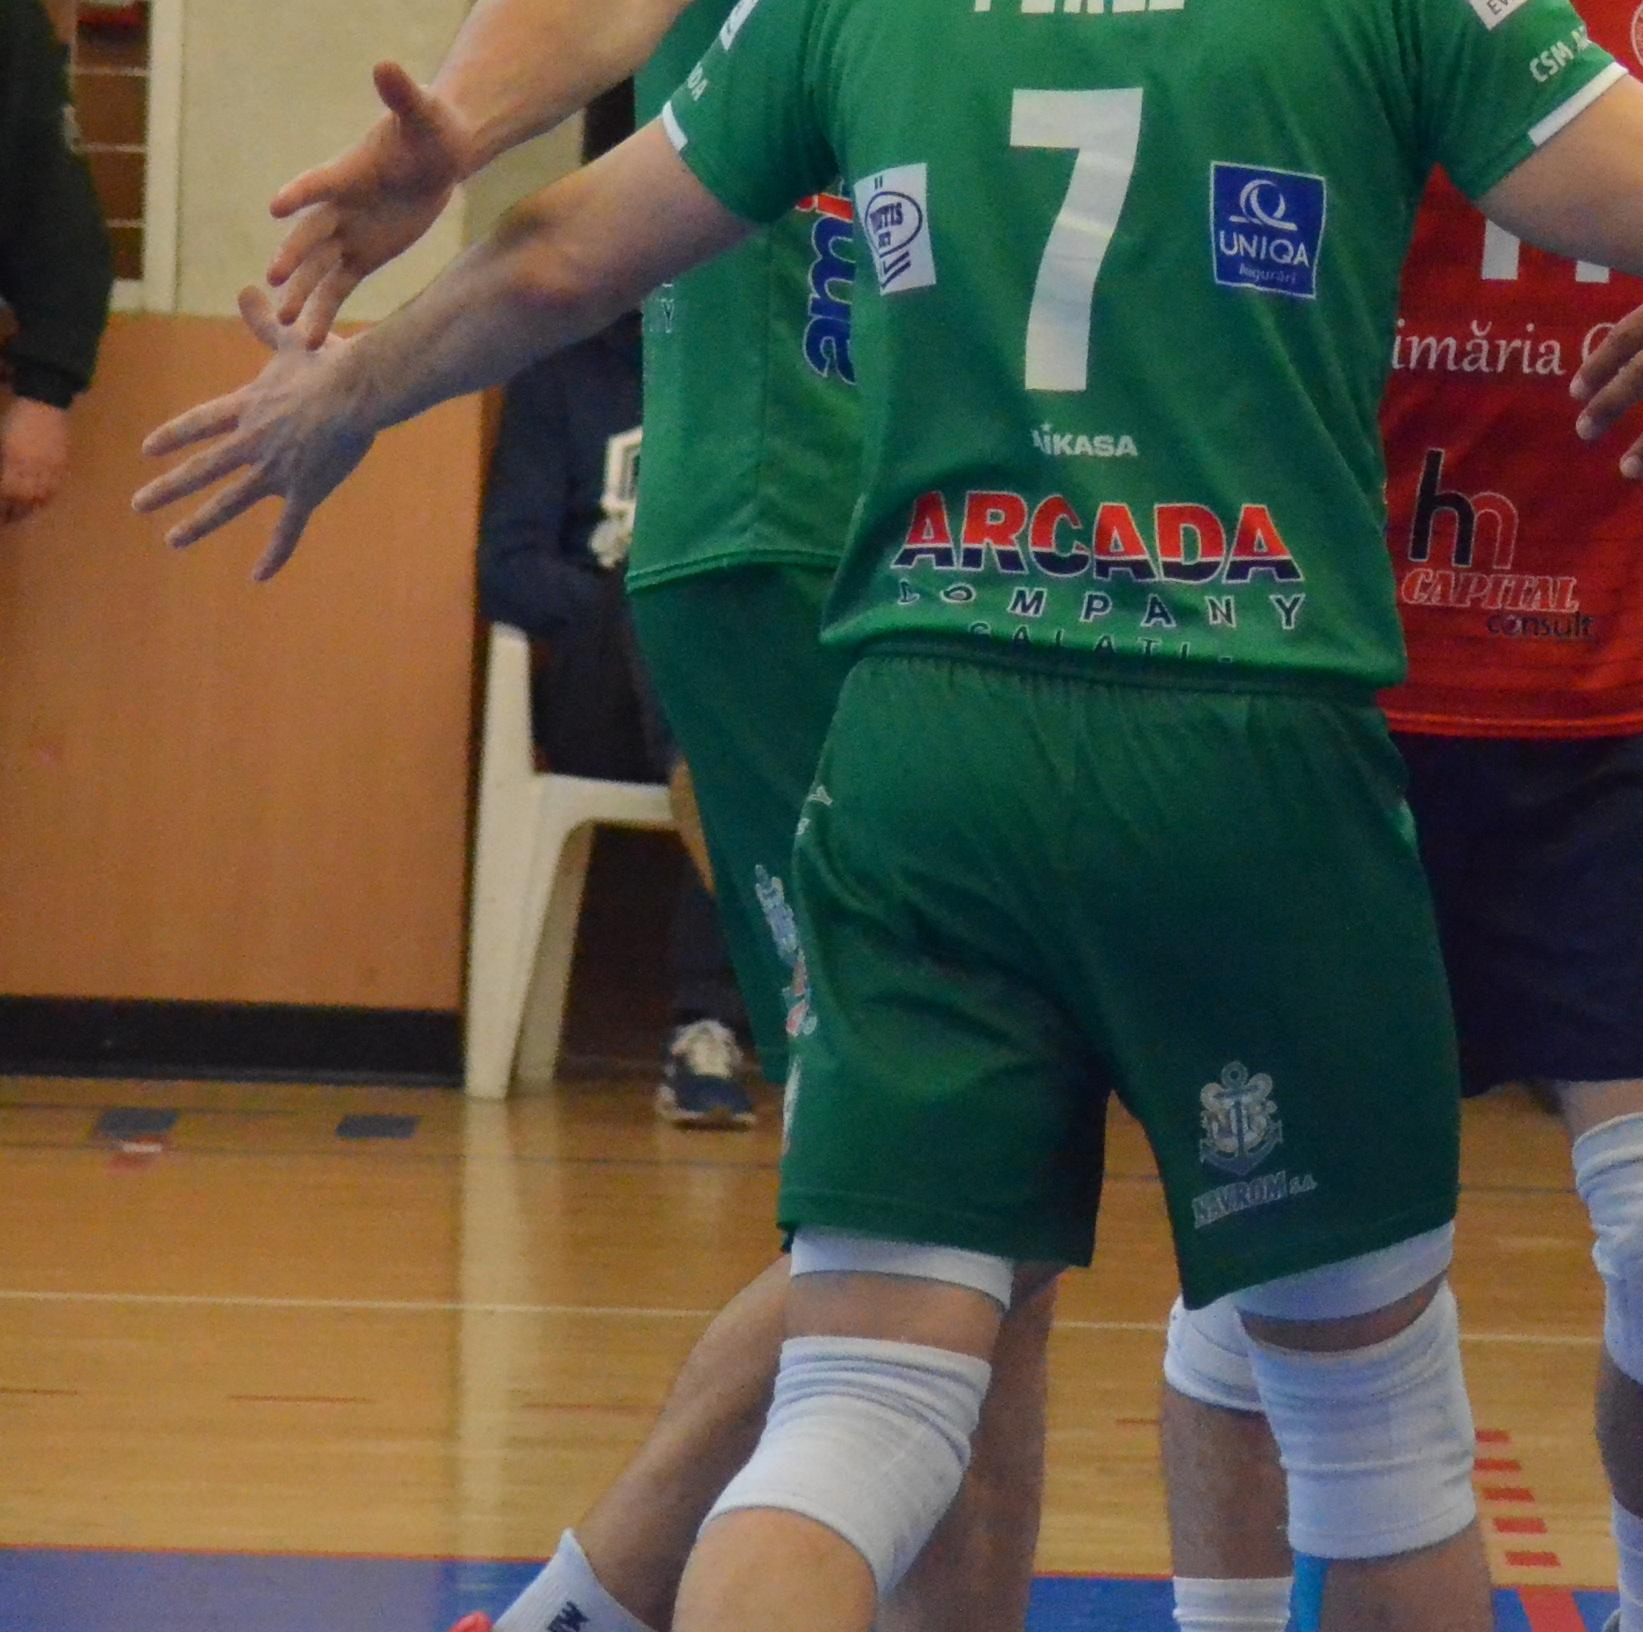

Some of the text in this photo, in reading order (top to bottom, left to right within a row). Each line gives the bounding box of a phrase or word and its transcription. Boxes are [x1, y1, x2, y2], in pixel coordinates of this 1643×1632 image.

[1529, 41, 1574, 83] CSM
[1010, 88, 1143, 391] 7
[1220, 230, 1310, 267] UNIQA
[891, 490, 1305, 584] ARCADA
[898, 580, 1306, 629] COMPANY
[1401, 568, 1580, 613] CAPITAL
[1488, 611, 1594, 640] consult
